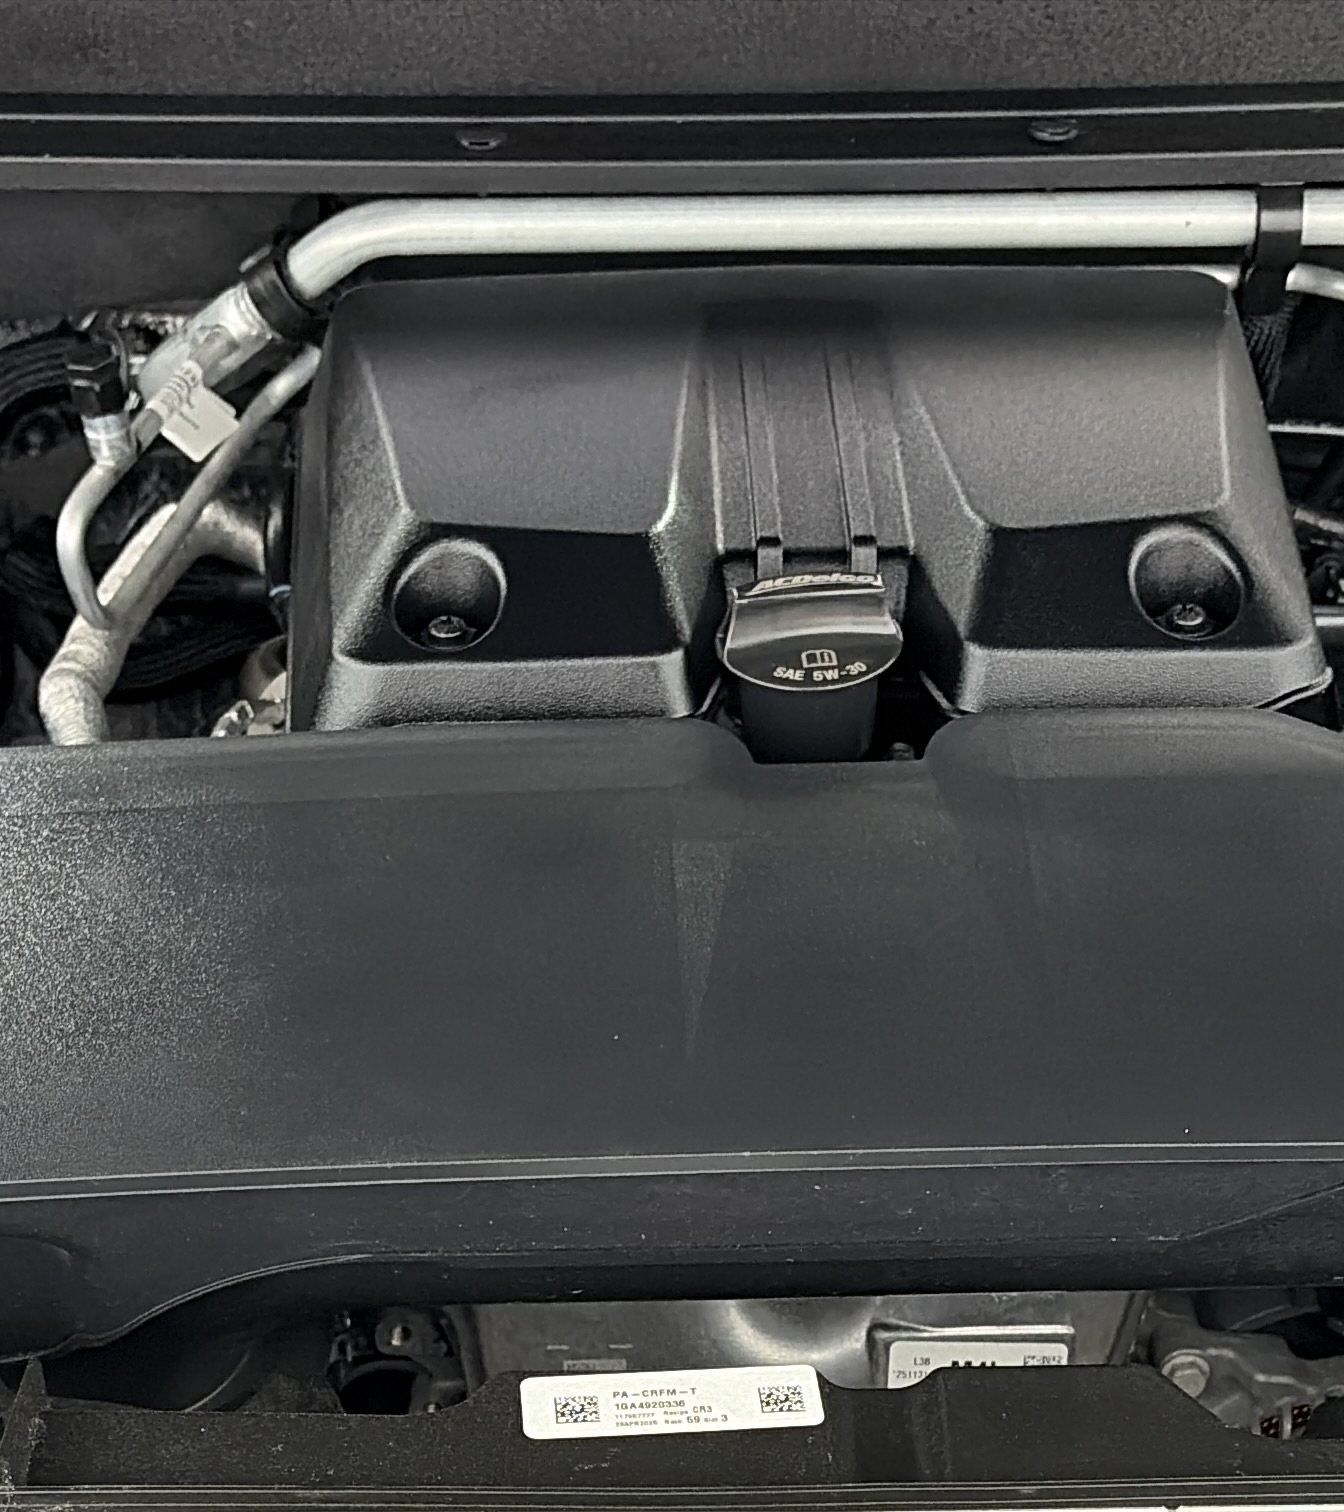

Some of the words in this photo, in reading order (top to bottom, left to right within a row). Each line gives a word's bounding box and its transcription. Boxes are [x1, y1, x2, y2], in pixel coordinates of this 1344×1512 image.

[751, 573, 875, 592] ACDelco
[773, 666, 805, 681] SAE
[813, 661, 867, 681] 5W-30
[692, 1405, 713, 1414] CR3
[721, 1414, 729, 1423] 3
